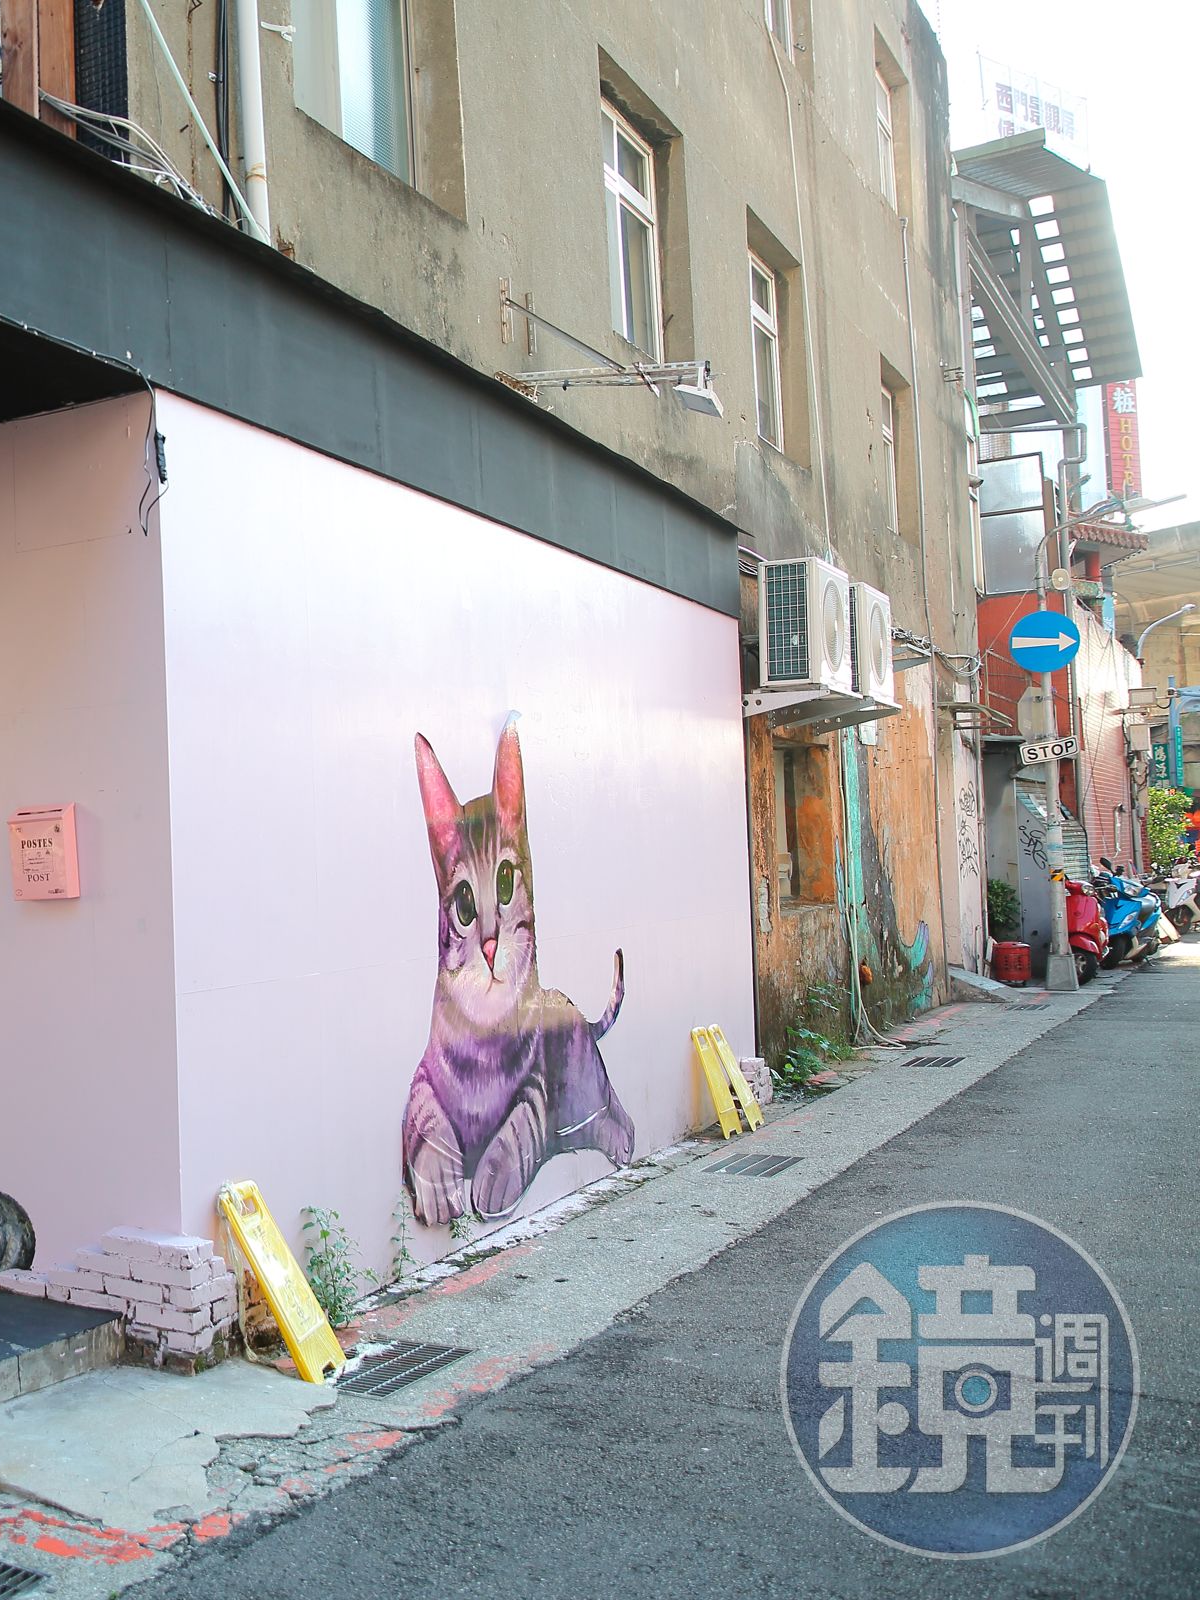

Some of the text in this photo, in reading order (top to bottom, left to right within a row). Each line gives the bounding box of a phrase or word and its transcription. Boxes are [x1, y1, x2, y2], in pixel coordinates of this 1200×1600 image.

[1120, 418, 1135, 486] HOTE
[1027, 741, 1074, 760] STOP
[21, 838, 53, 849] POSTES
[27, 873, 50, 882] POST
